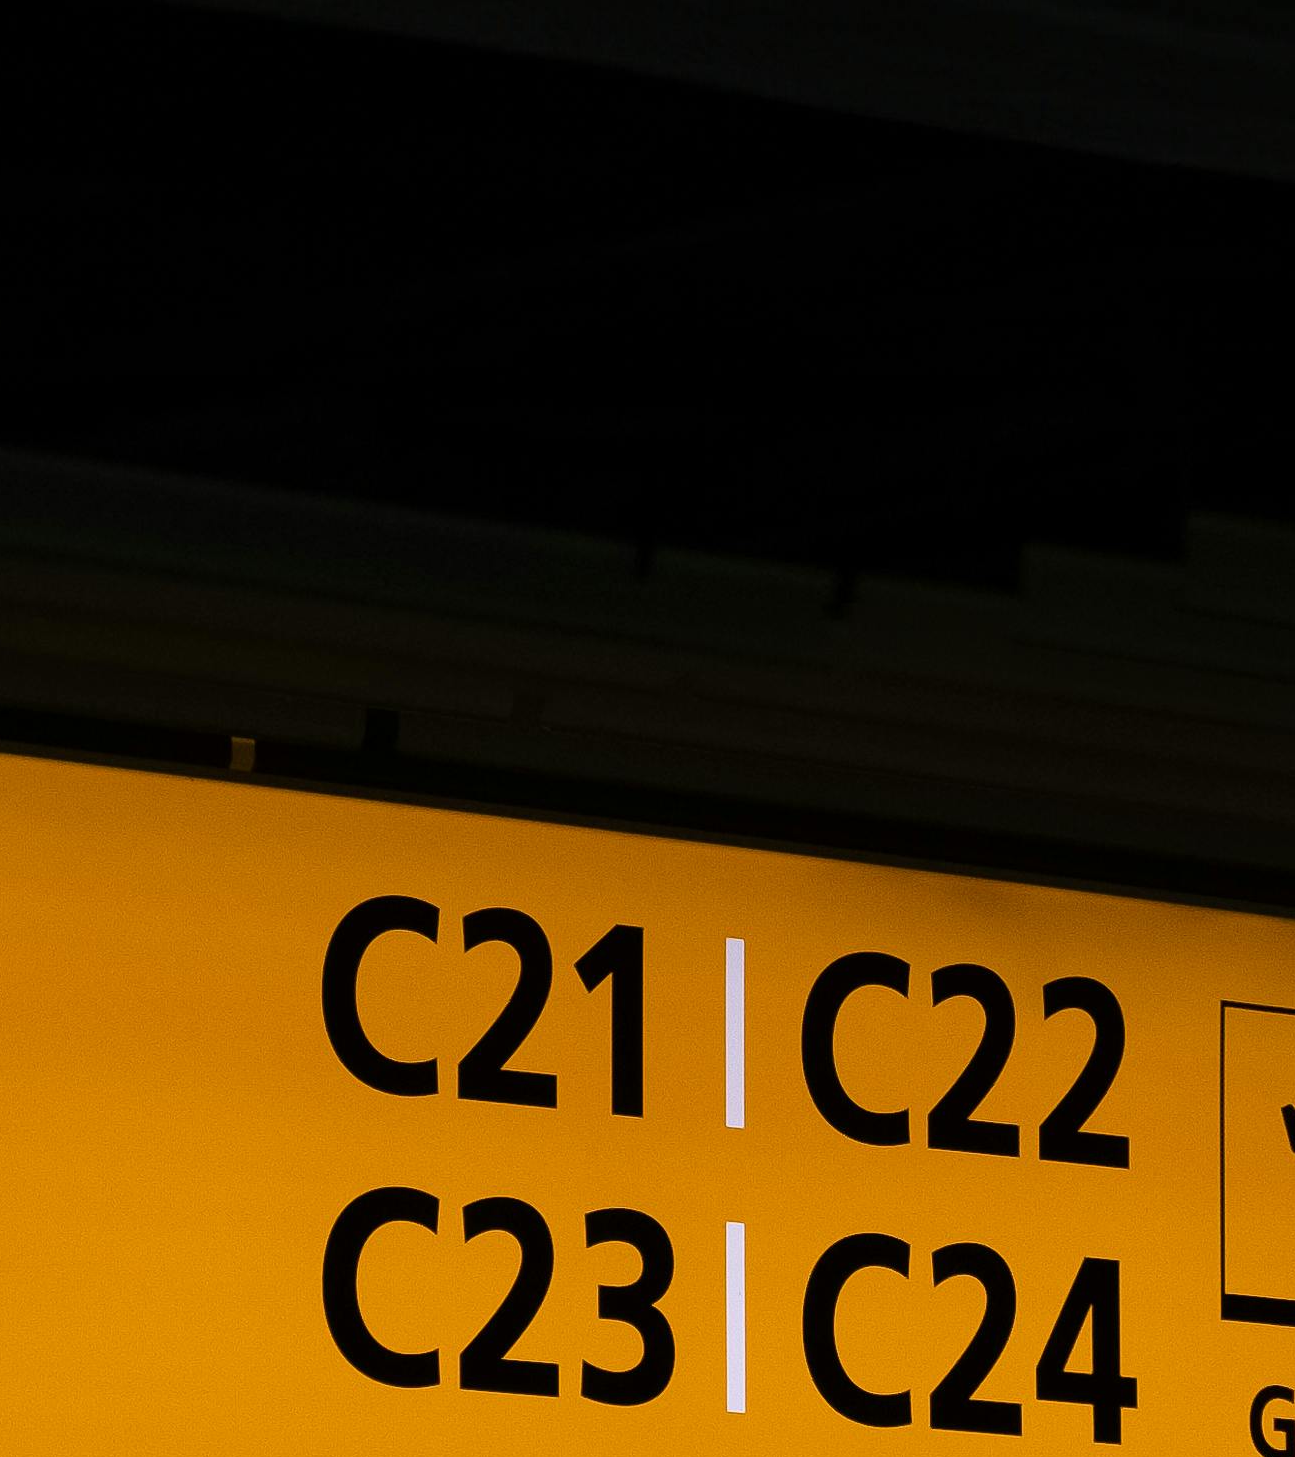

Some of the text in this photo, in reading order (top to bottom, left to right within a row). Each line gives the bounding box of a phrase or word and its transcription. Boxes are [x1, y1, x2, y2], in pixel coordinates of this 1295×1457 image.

[320, 893, 1131, 1171] C21 C22
[321, 1185, 1139, 1447] C23 C24
